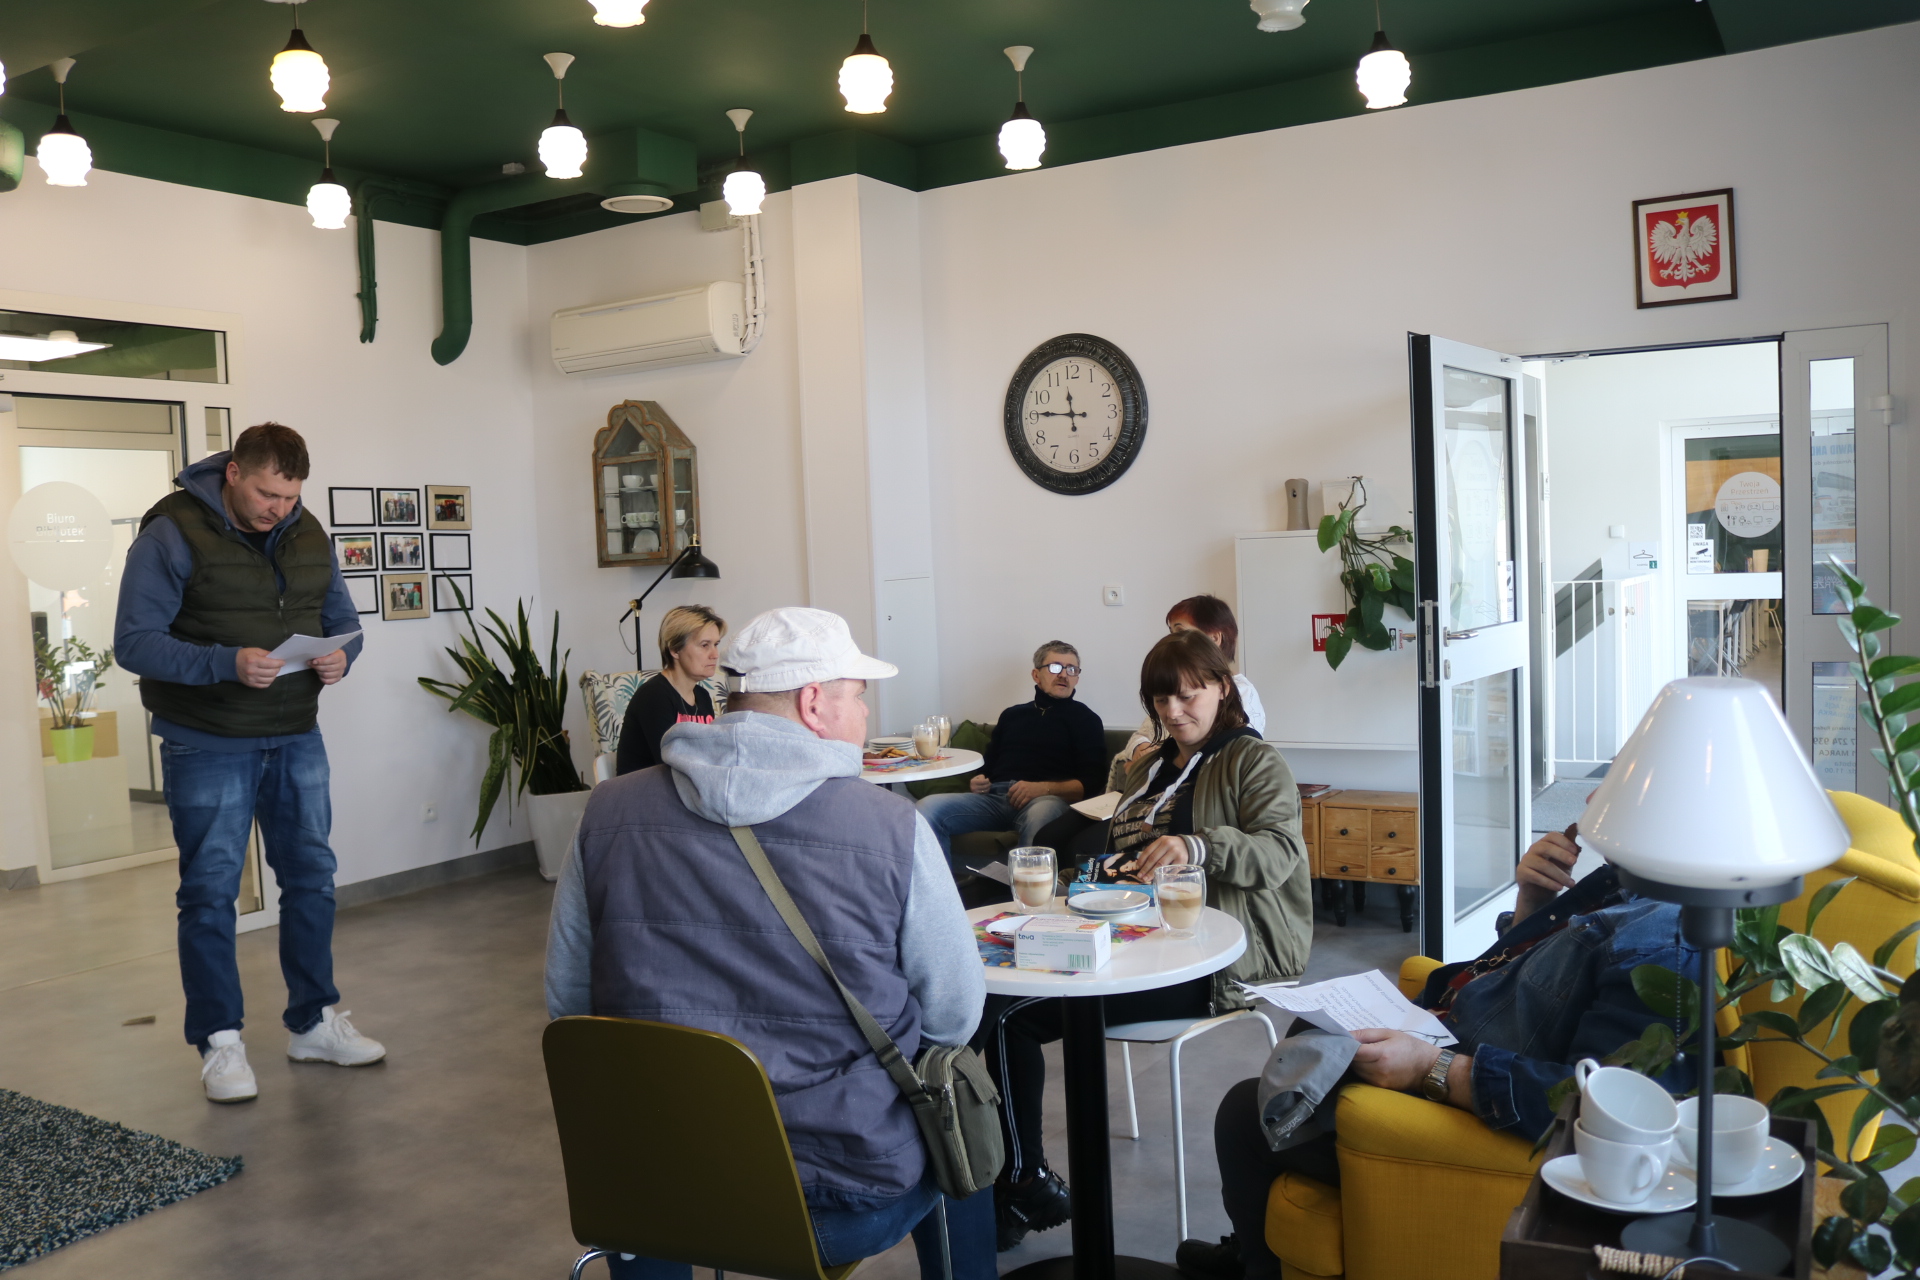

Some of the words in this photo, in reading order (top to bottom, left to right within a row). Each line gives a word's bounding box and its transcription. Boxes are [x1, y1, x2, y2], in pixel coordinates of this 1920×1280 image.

[1065, 364, 1080, 380] 12
[1088, 368, 1093, 383] 1
[1048, 373, 1060, 387] 11
[1035, 390, 1050, 404] 10
[1102, 383, 1111, 398] 2
[1030, 410, 1040, 424] 9
[1107, 404, 1117, 419] 3
[1036, 430, 1046, 445] 8
[1103, 427, 1113, 440] 4
[1050, 445, 1059, 459] 7
[1069, 450, 1080, 464] 6
[1088, 443, 1099, 458] 5
[1740, 480, 1760, 488] Twoja
[46, 513, 76, 524] Biuro
